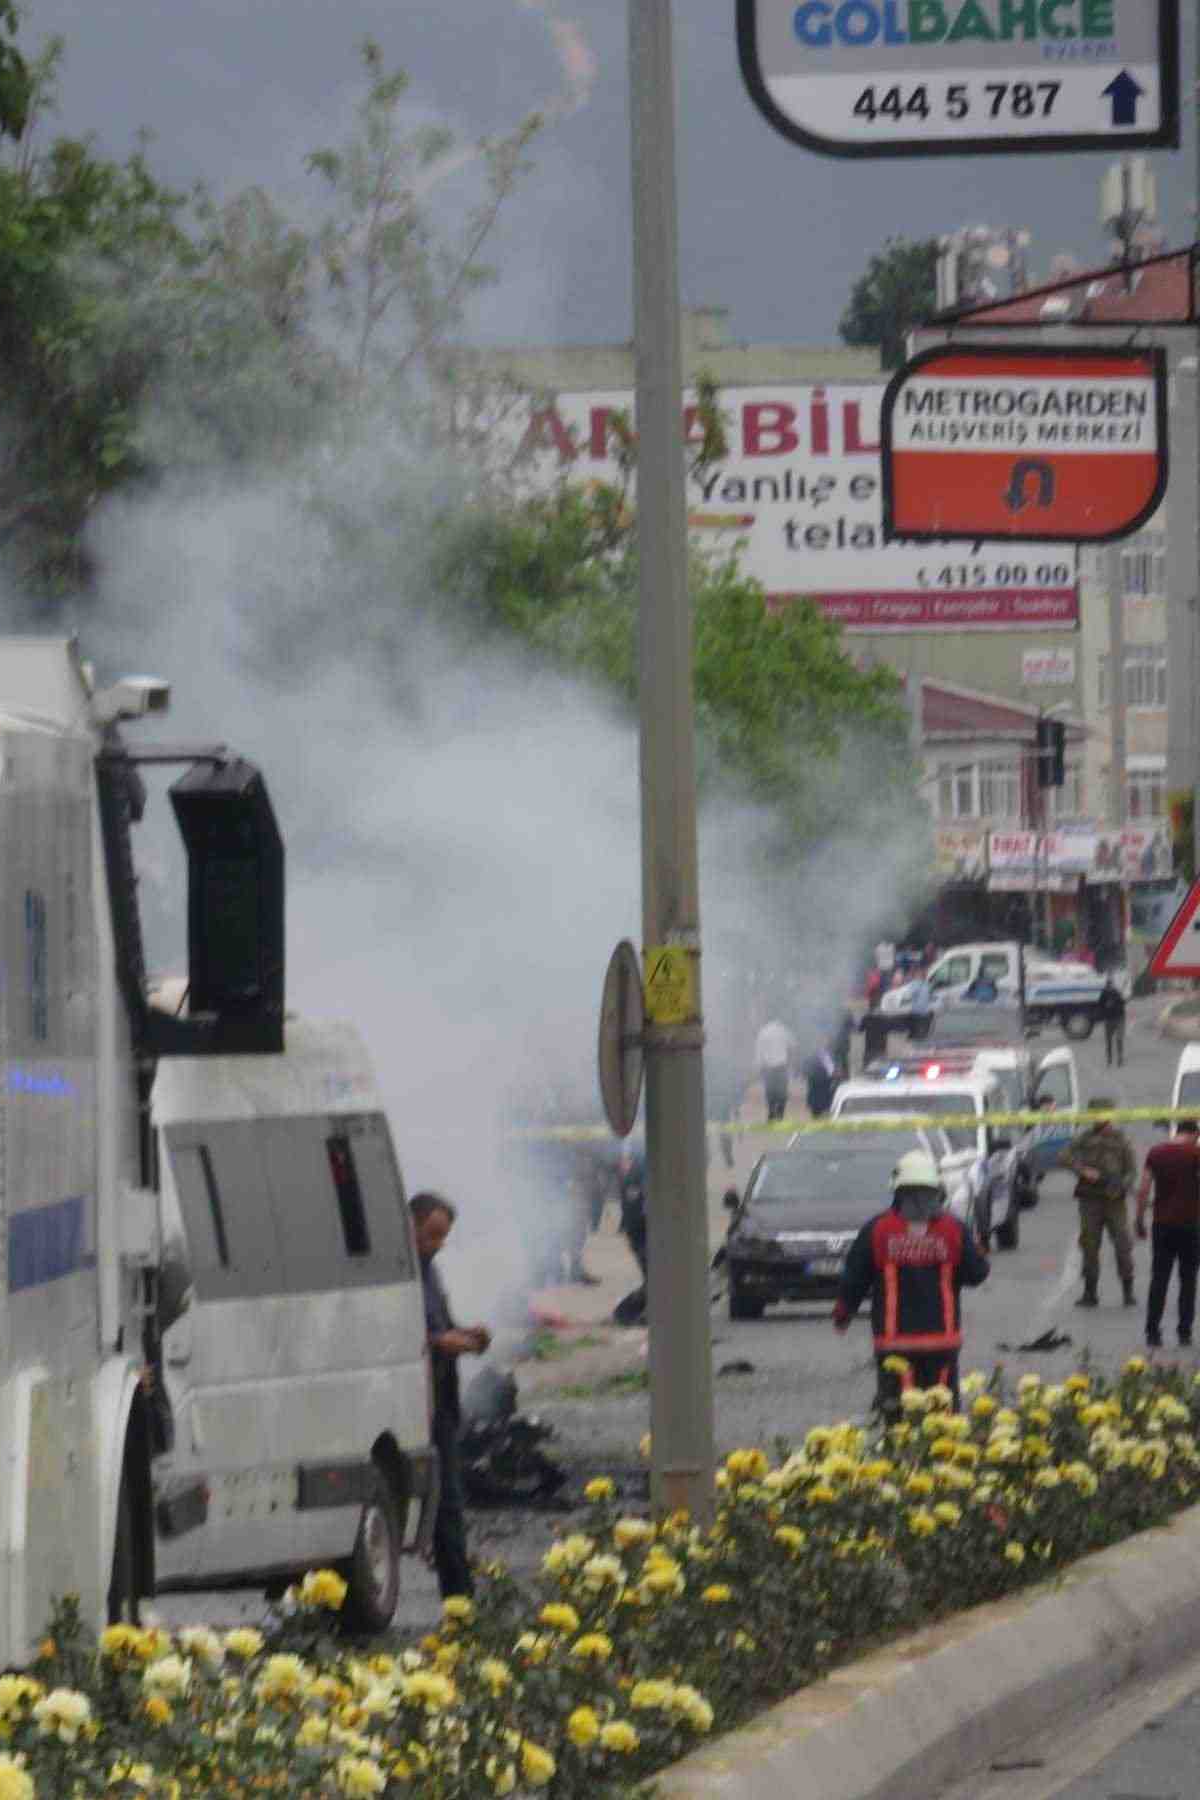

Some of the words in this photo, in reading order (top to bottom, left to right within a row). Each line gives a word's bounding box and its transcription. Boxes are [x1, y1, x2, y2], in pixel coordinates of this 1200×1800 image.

[853, 84, 929, 122] 444
[946, 82, 970, 119] 5
[984, 80, 1062, 119] 787
[904, 388, 1147, 416] METROGARDEN
[1039, 419, 1142, 442] MERKEZİ
